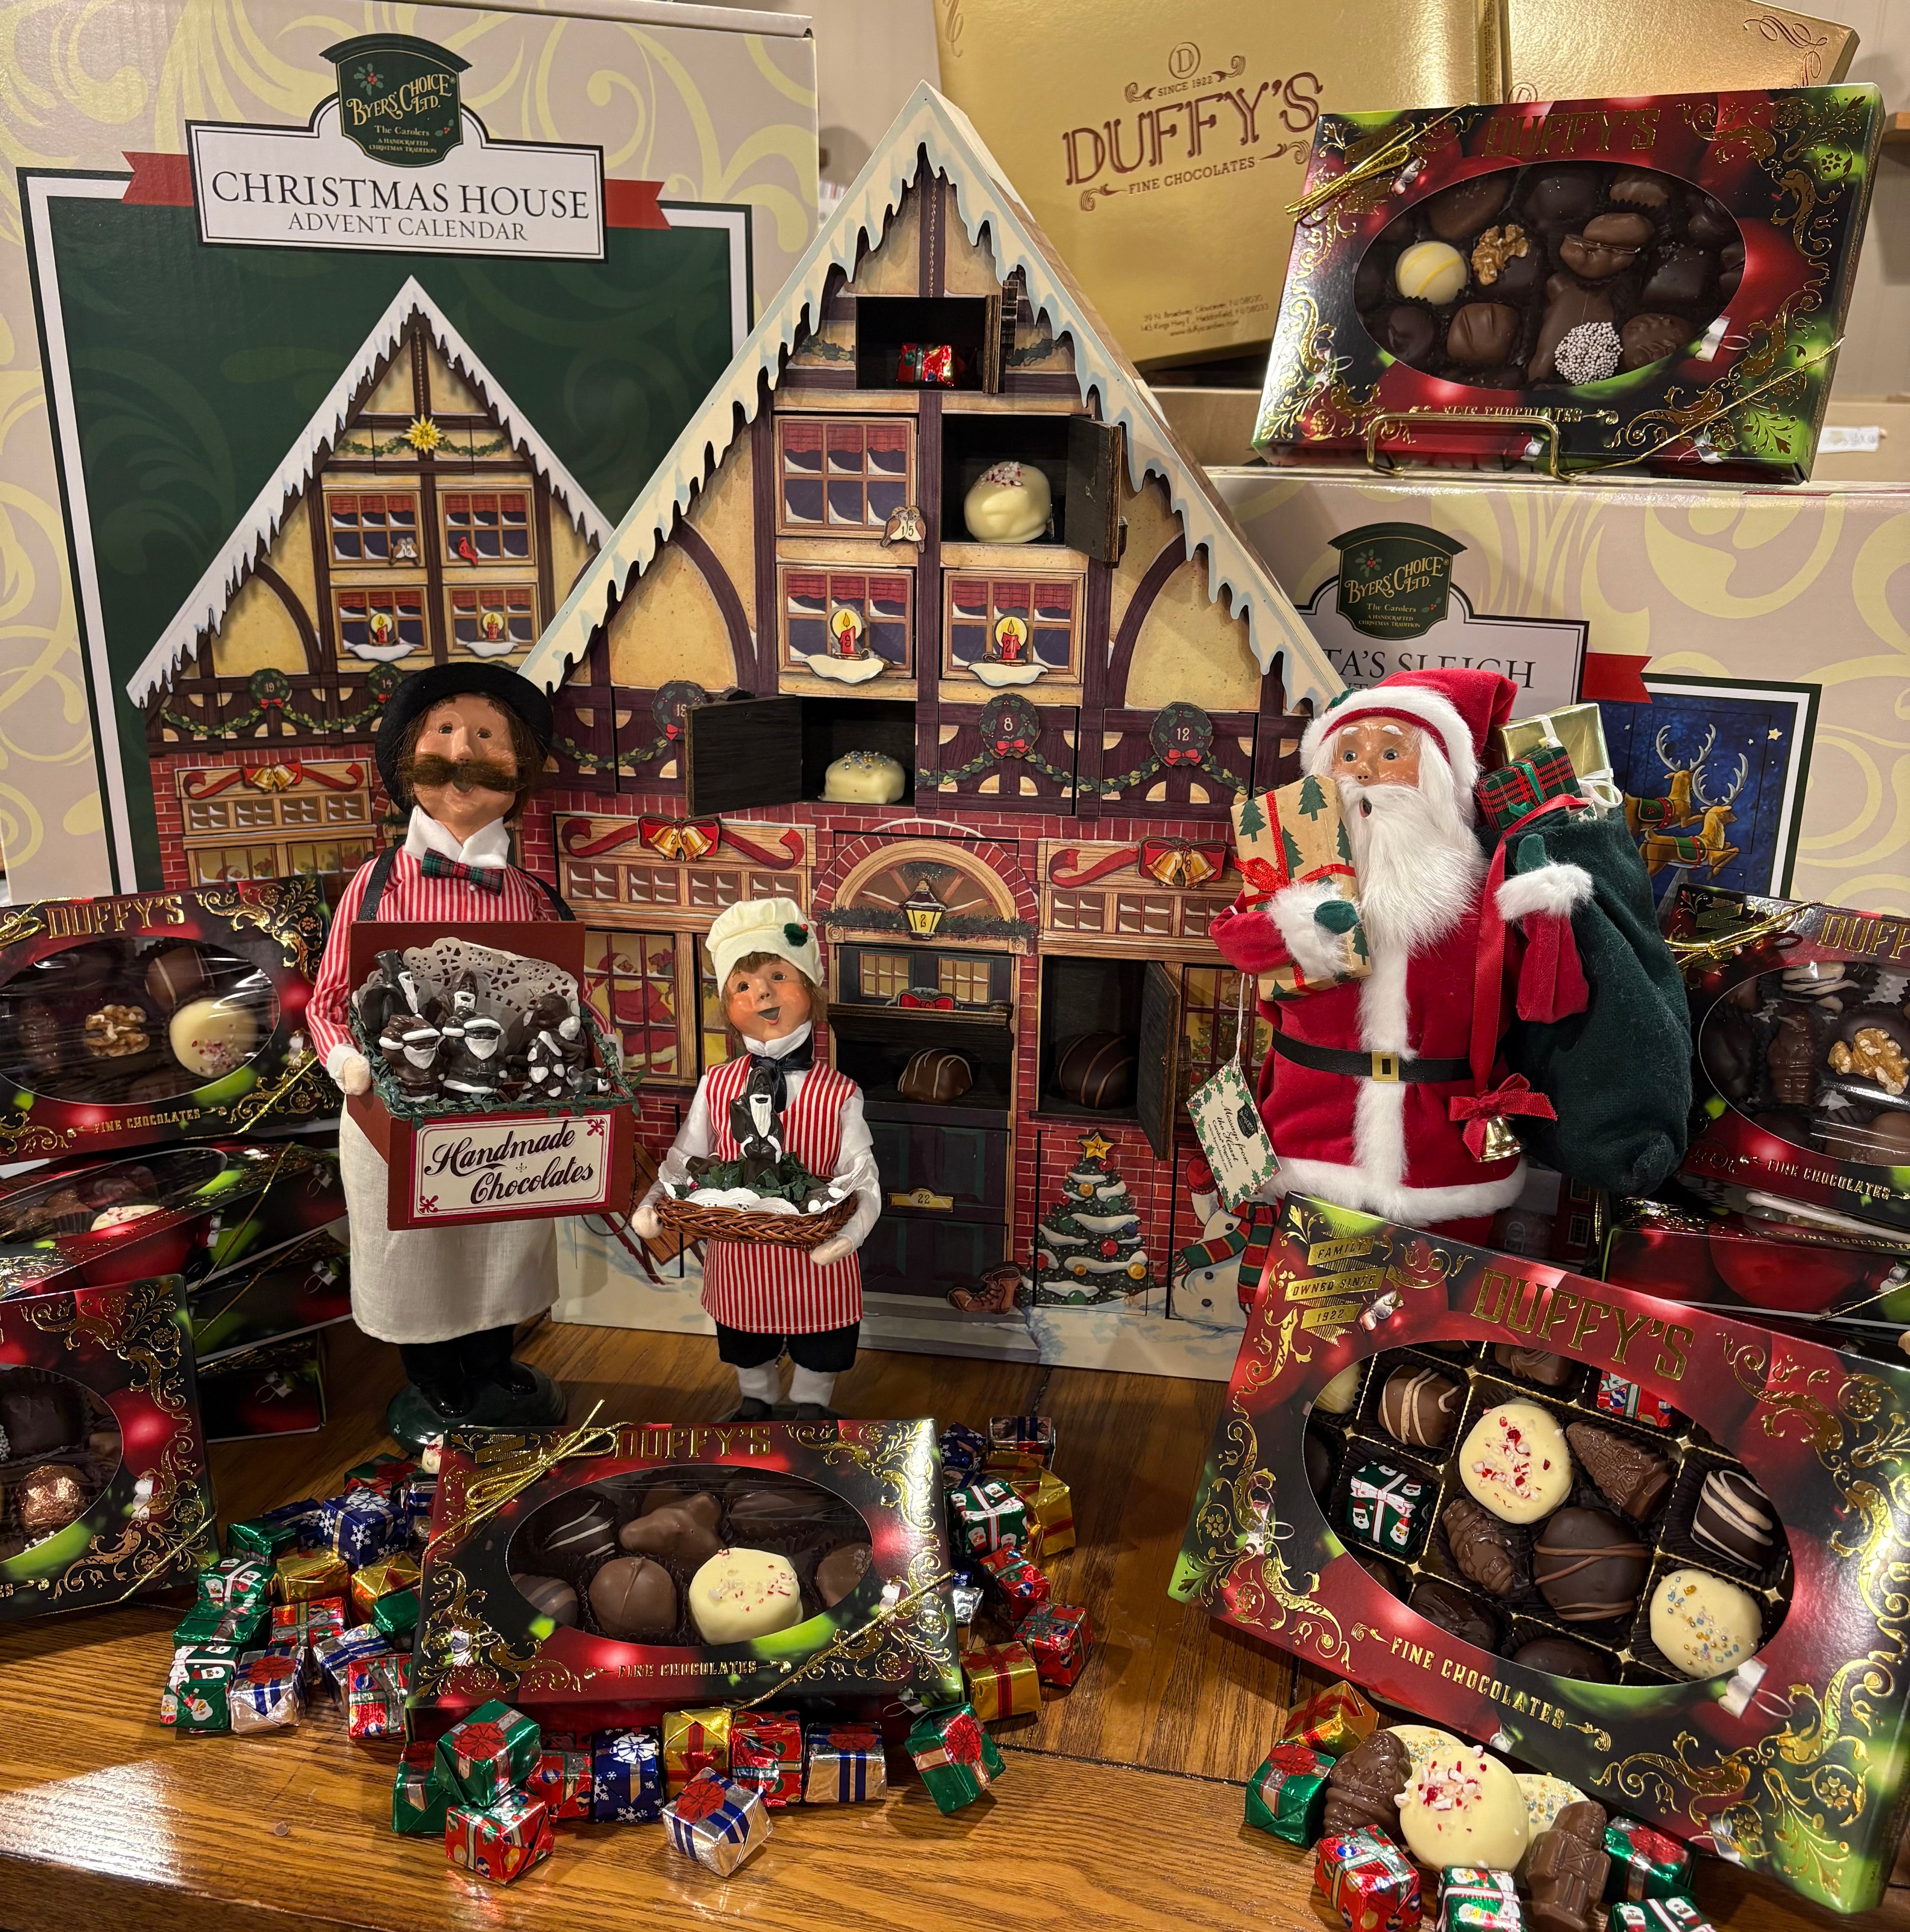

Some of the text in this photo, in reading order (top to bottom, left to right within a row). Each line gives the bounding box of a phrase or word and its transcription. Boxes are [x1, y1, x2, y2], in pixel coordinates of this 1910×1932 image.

[1157, 76, 1213, 96] SINCE 1922
[411, 95, 440, 115] LTD.
[374, 125, 429, 136] The Carolers
[1062, 72, 1323, 186] DUFFY'S
[1482, 109, 1660, 156] DUFFY'S
[1128, 156, 1255, 195] FINE CHOCOLATES
[212, 171, 589, 219] CHRISTMAS HOUSE
[288, 212, 528, 241] ADVENT CALENDAR
[901, 526, 914, 536] 15
[1404, 576, 1431, 593] LTD.
[1384, 604, 1416, 612] Carolers
[380, 631, 385, 639] 9
[489, 627, 496, 635] 21
[844, 637, 852, 648] 9
[1005, 639, 1015, 653] 21
[1322, 649, 1385, 678] TA'S
[266, 682, 274, 692] 19
[382, 679, 392, 689] 14
[1004, 717, 1013, 732] 8
[1177, 728, 1190, 741] 12
[671, 834, 687, 845] 20
[1174, 859, 1191, 873] 18
[45, 895, 185, 939] DUFFY'S
[921, 914, 926, 927] 2
[1817, 913, 1910, 959] DUFF
[93, 1108, 201, 1134] FINE CHOCOLATES
[1222, 1101, 1239, 1141] Message
[1234, 1144, 1248, 1165] from
[424, 1120, 575, 1176] Handmade
[1094, 1143, 1103, 1152] 4
[1223, 1132, 1239, 1162] Heart
[1223, 1145, 1232, 1168] Figurine
[470, 1156, 593, 1204] Chocolates
[1768, 1159, 1890, 1200] FINE CHOCOLATES
[918, 1194, 930, 1204] 22
[1318, 1241, 1364, 1259] FAMILY
[1832, 1237, 1910, 1250] CHOCOLATE
[1293, 1274, 1376, 1296] OWNED SINCE
[1317, 1309, 1345, 1323] 1922
[1470, 1267, 1694, 1380] DUFFY'S
[613, 1426, 770, 1459] DUFFY'S
[618, 1661, 757, 1678] FINE CHOCOLATES
[1390, 1635, 1565, 1730] FINE CHOCOLATES
